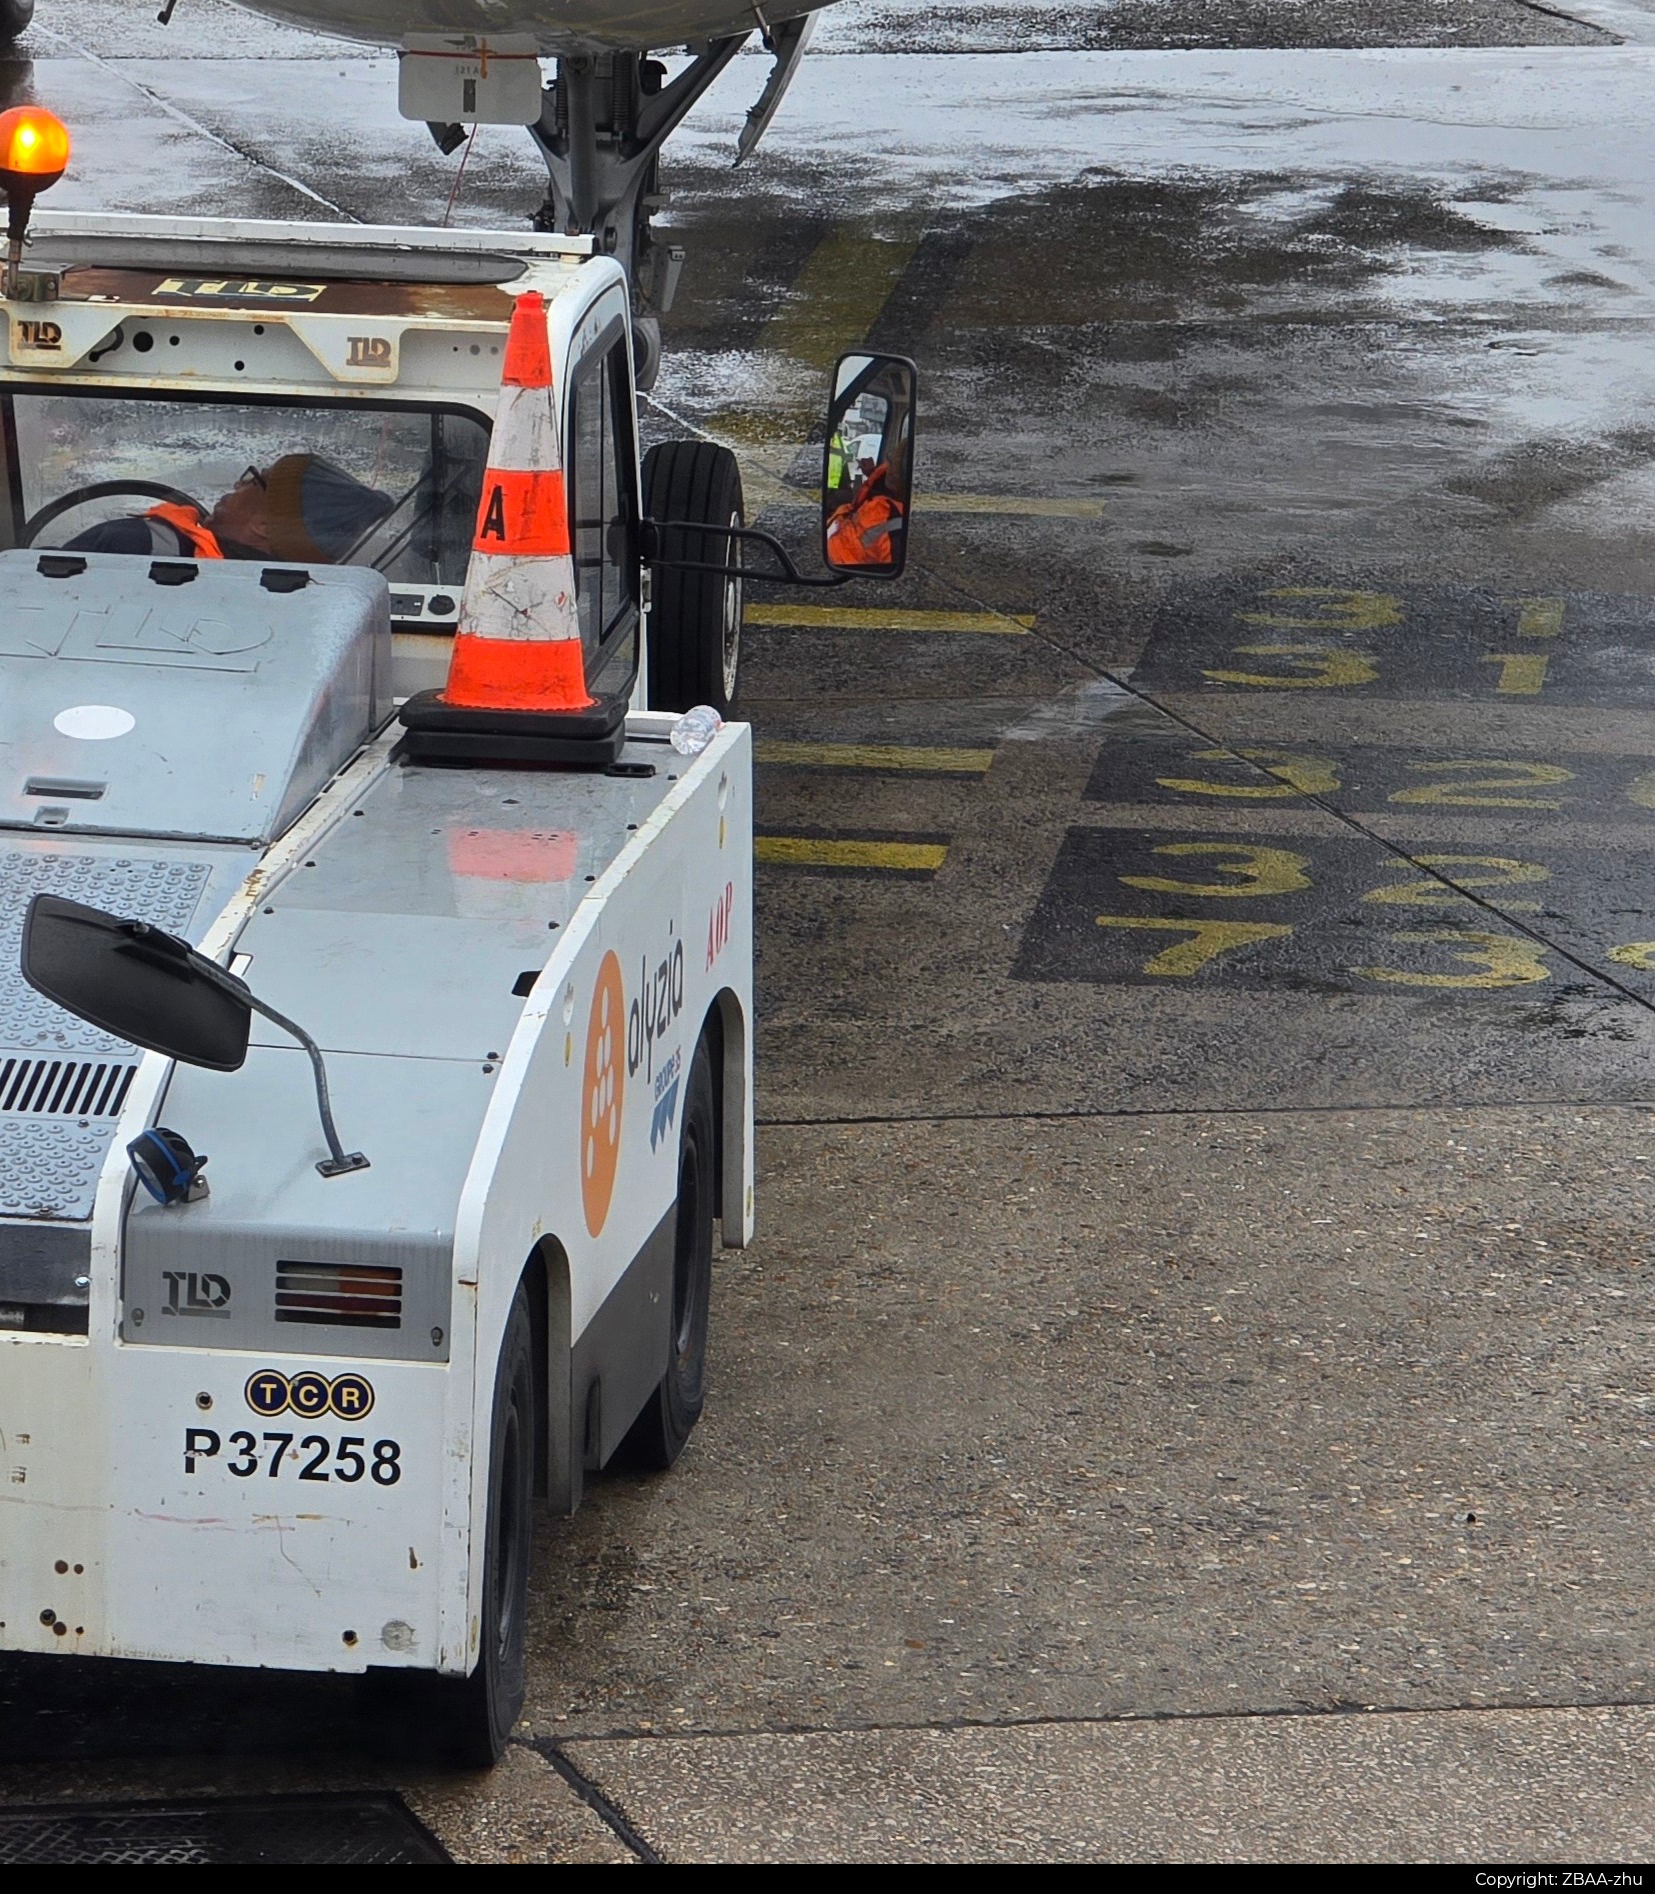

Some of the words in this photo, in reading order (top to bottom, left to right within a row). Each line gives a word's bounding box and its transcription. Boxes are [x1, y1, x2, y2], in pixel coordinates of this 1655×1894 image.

[17, 320, 62, 351] TLD
[346, 336, 392, 367] TLD
[480, 484, 506, 542] A
[705, 880, 733, 974] AOP
[628, 919, 683, 1085] alyzia
[161, 1271, 232, 1319] TLD
[257, 1379, 363, 1412] TCR
[183, 1427, 402, 1486] P37258
